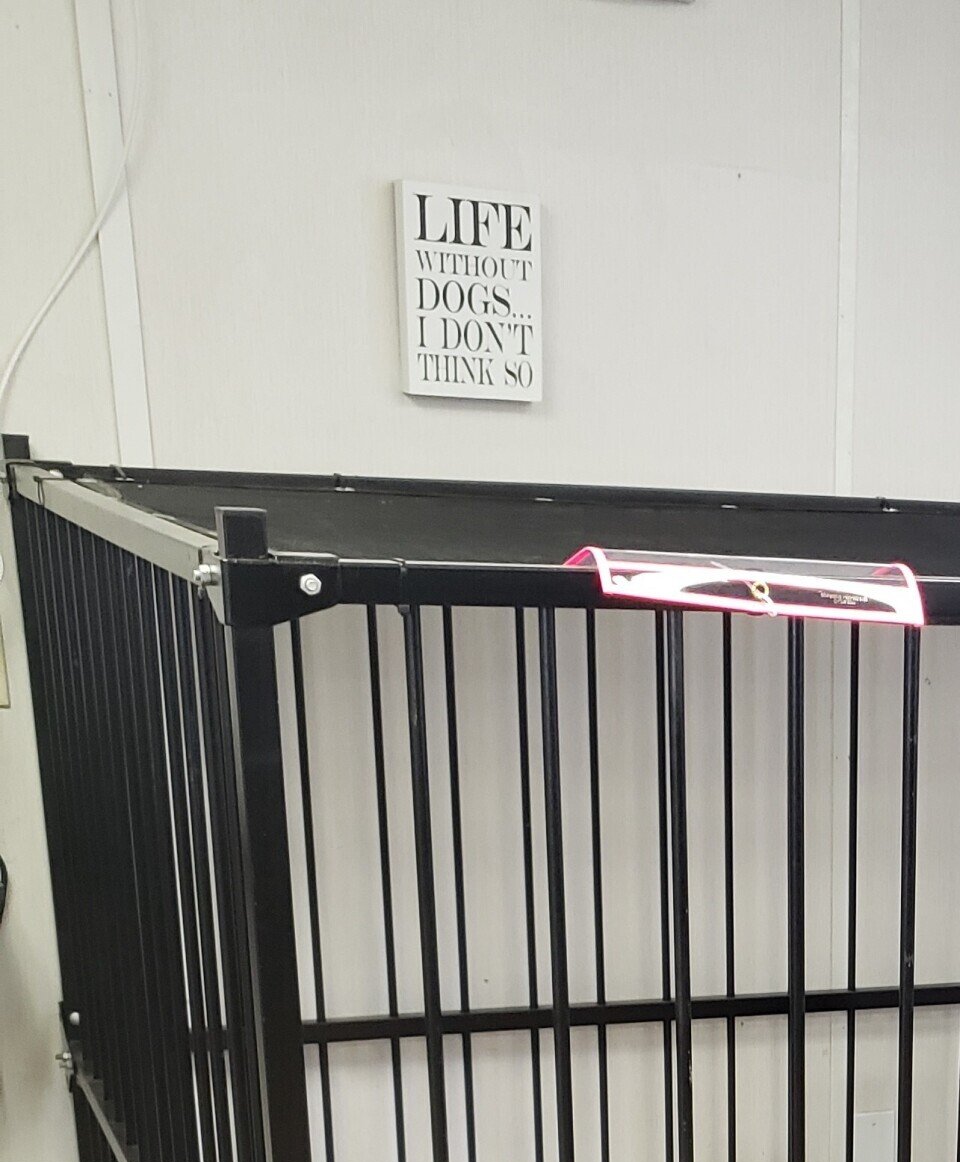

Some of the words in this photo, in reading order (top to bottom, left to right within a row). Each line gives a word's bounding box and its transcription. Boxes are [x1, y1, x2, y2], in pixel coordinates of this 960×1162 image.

[413, 193, 532, 252] LIFE
[415, 249, 533, 282] WITHOUT
[415, 277, 532, 319] DOGS...
[417, 316, 426, 348] I
[440, 317, 534, 356] DON'T
[417, 353, 495, 386] THINK
[504, 359, 533, 389] SO
